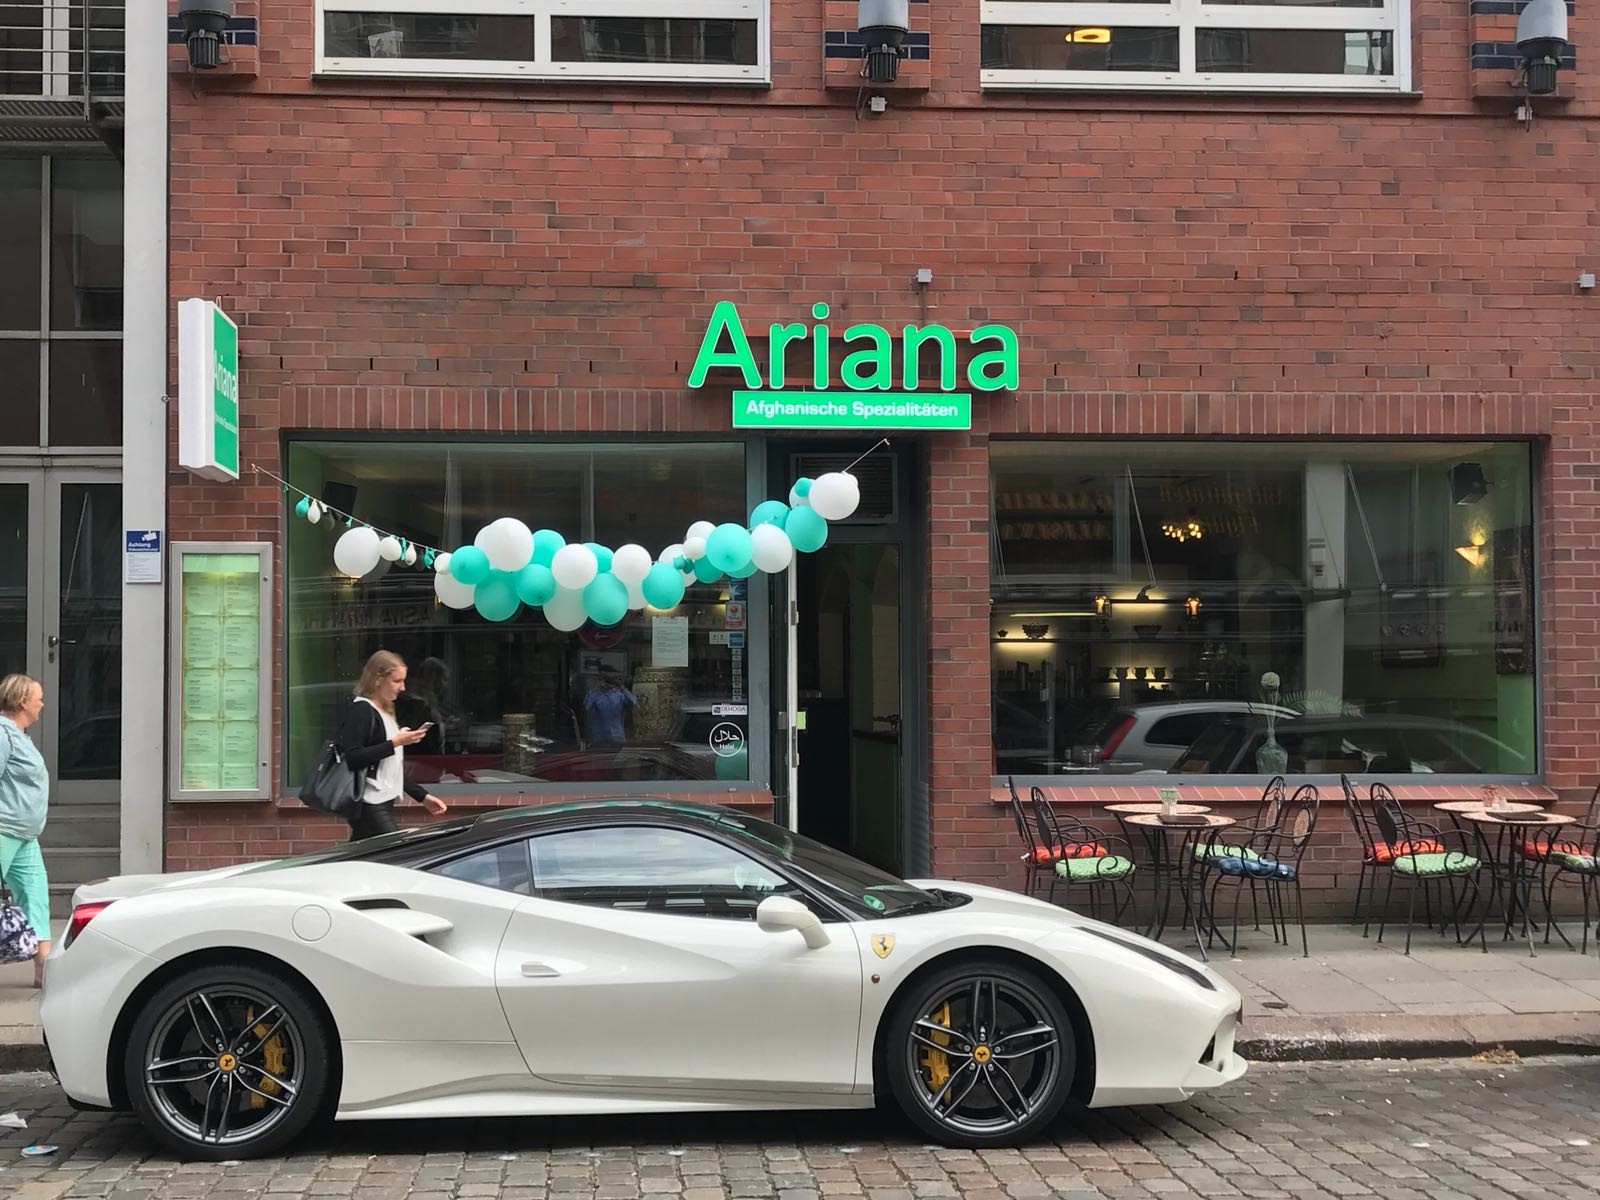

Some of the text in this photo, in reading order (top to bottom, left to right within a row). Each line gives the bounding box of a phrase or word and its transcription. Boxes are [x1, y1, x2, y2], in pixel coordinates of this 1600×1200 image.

[688, 300, 1019, 391] Ariana
[746, 399, 958, 419] Afghanische Spezialitäten
[714, 730, 740, 742] حلال
